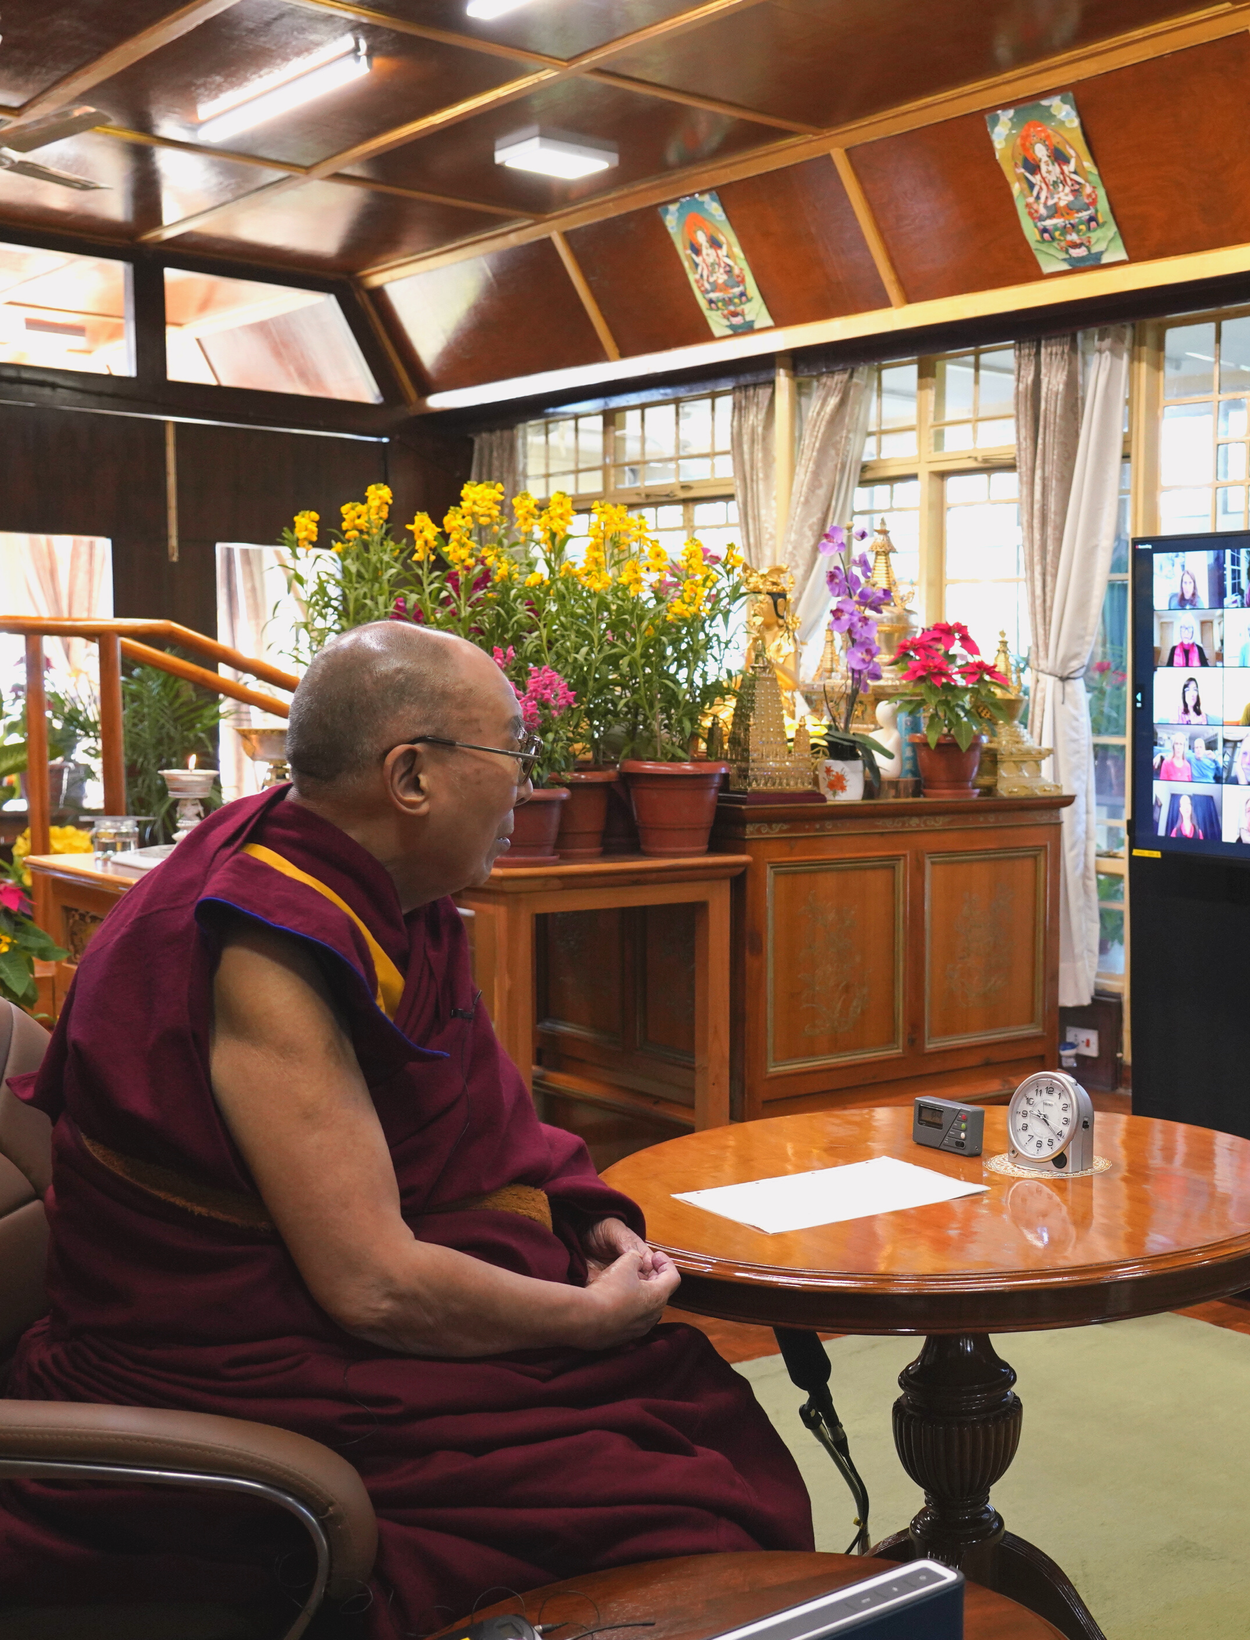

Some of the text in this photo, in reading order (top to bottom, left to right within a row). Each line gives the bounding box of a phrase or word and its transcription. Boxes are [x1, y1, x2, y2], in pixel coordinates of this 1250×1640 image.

[1062, 1117, 1068, 1125] 3
[1022, 1123, 1028, 1131] 8
[1036, 1140, 1043, 1148] 6
[1047, 1138, 1054, 1146] 5
